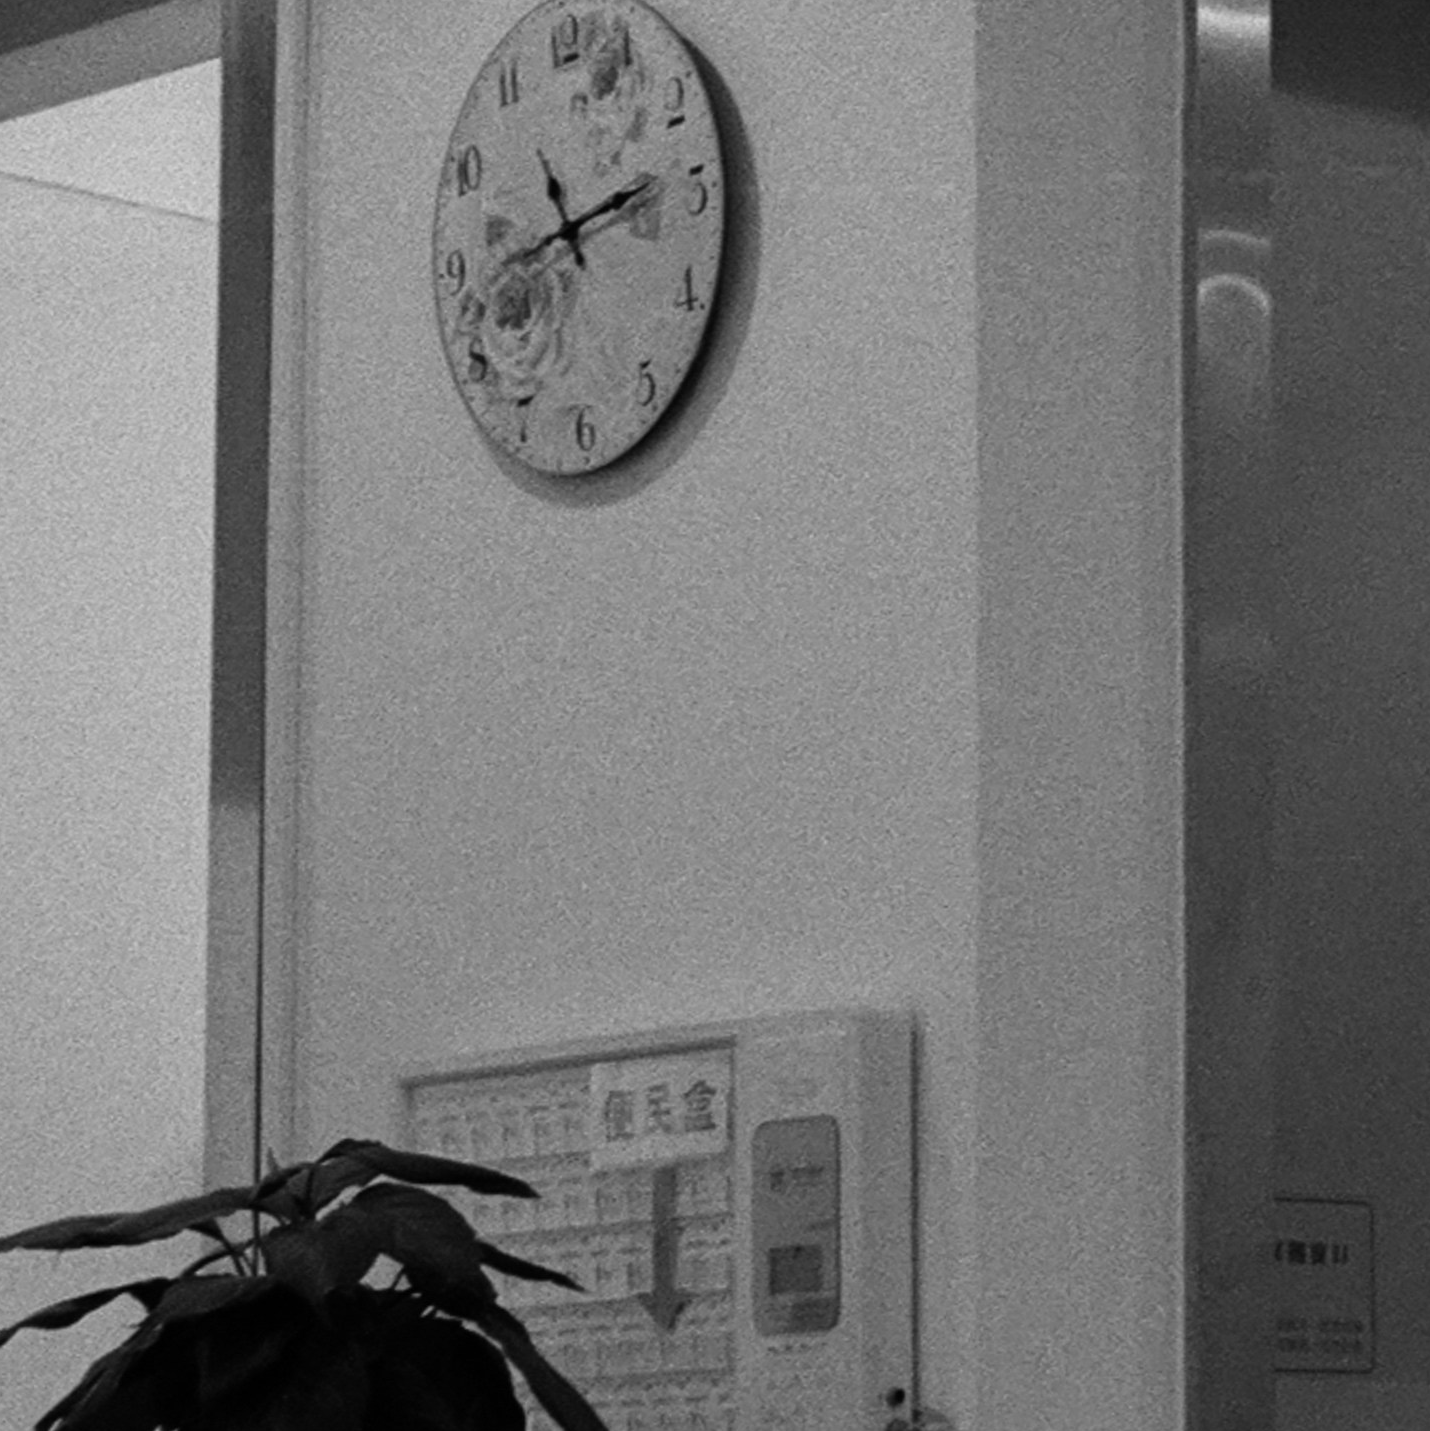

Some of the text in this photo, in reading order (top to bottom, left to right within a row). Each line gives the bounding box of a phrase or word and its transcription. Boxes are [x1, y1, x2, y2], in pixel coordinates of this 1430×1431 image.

[498, 63, 521, 108] 11
[666, 77, 686, 129] 2
[457, 145, 483, 197] 10
[687, 164, 709, 216] 3
[445, 249, 467, 295] 9
[674, 266, 696, 312] 4
[467, 338, 489, 382] 8
[636, 359, 657, 406] 5
[516, 395, 533, 442] 7
[573, 408, 597, 452] 6
[603, 1079, 718, 1143] 便民盒
